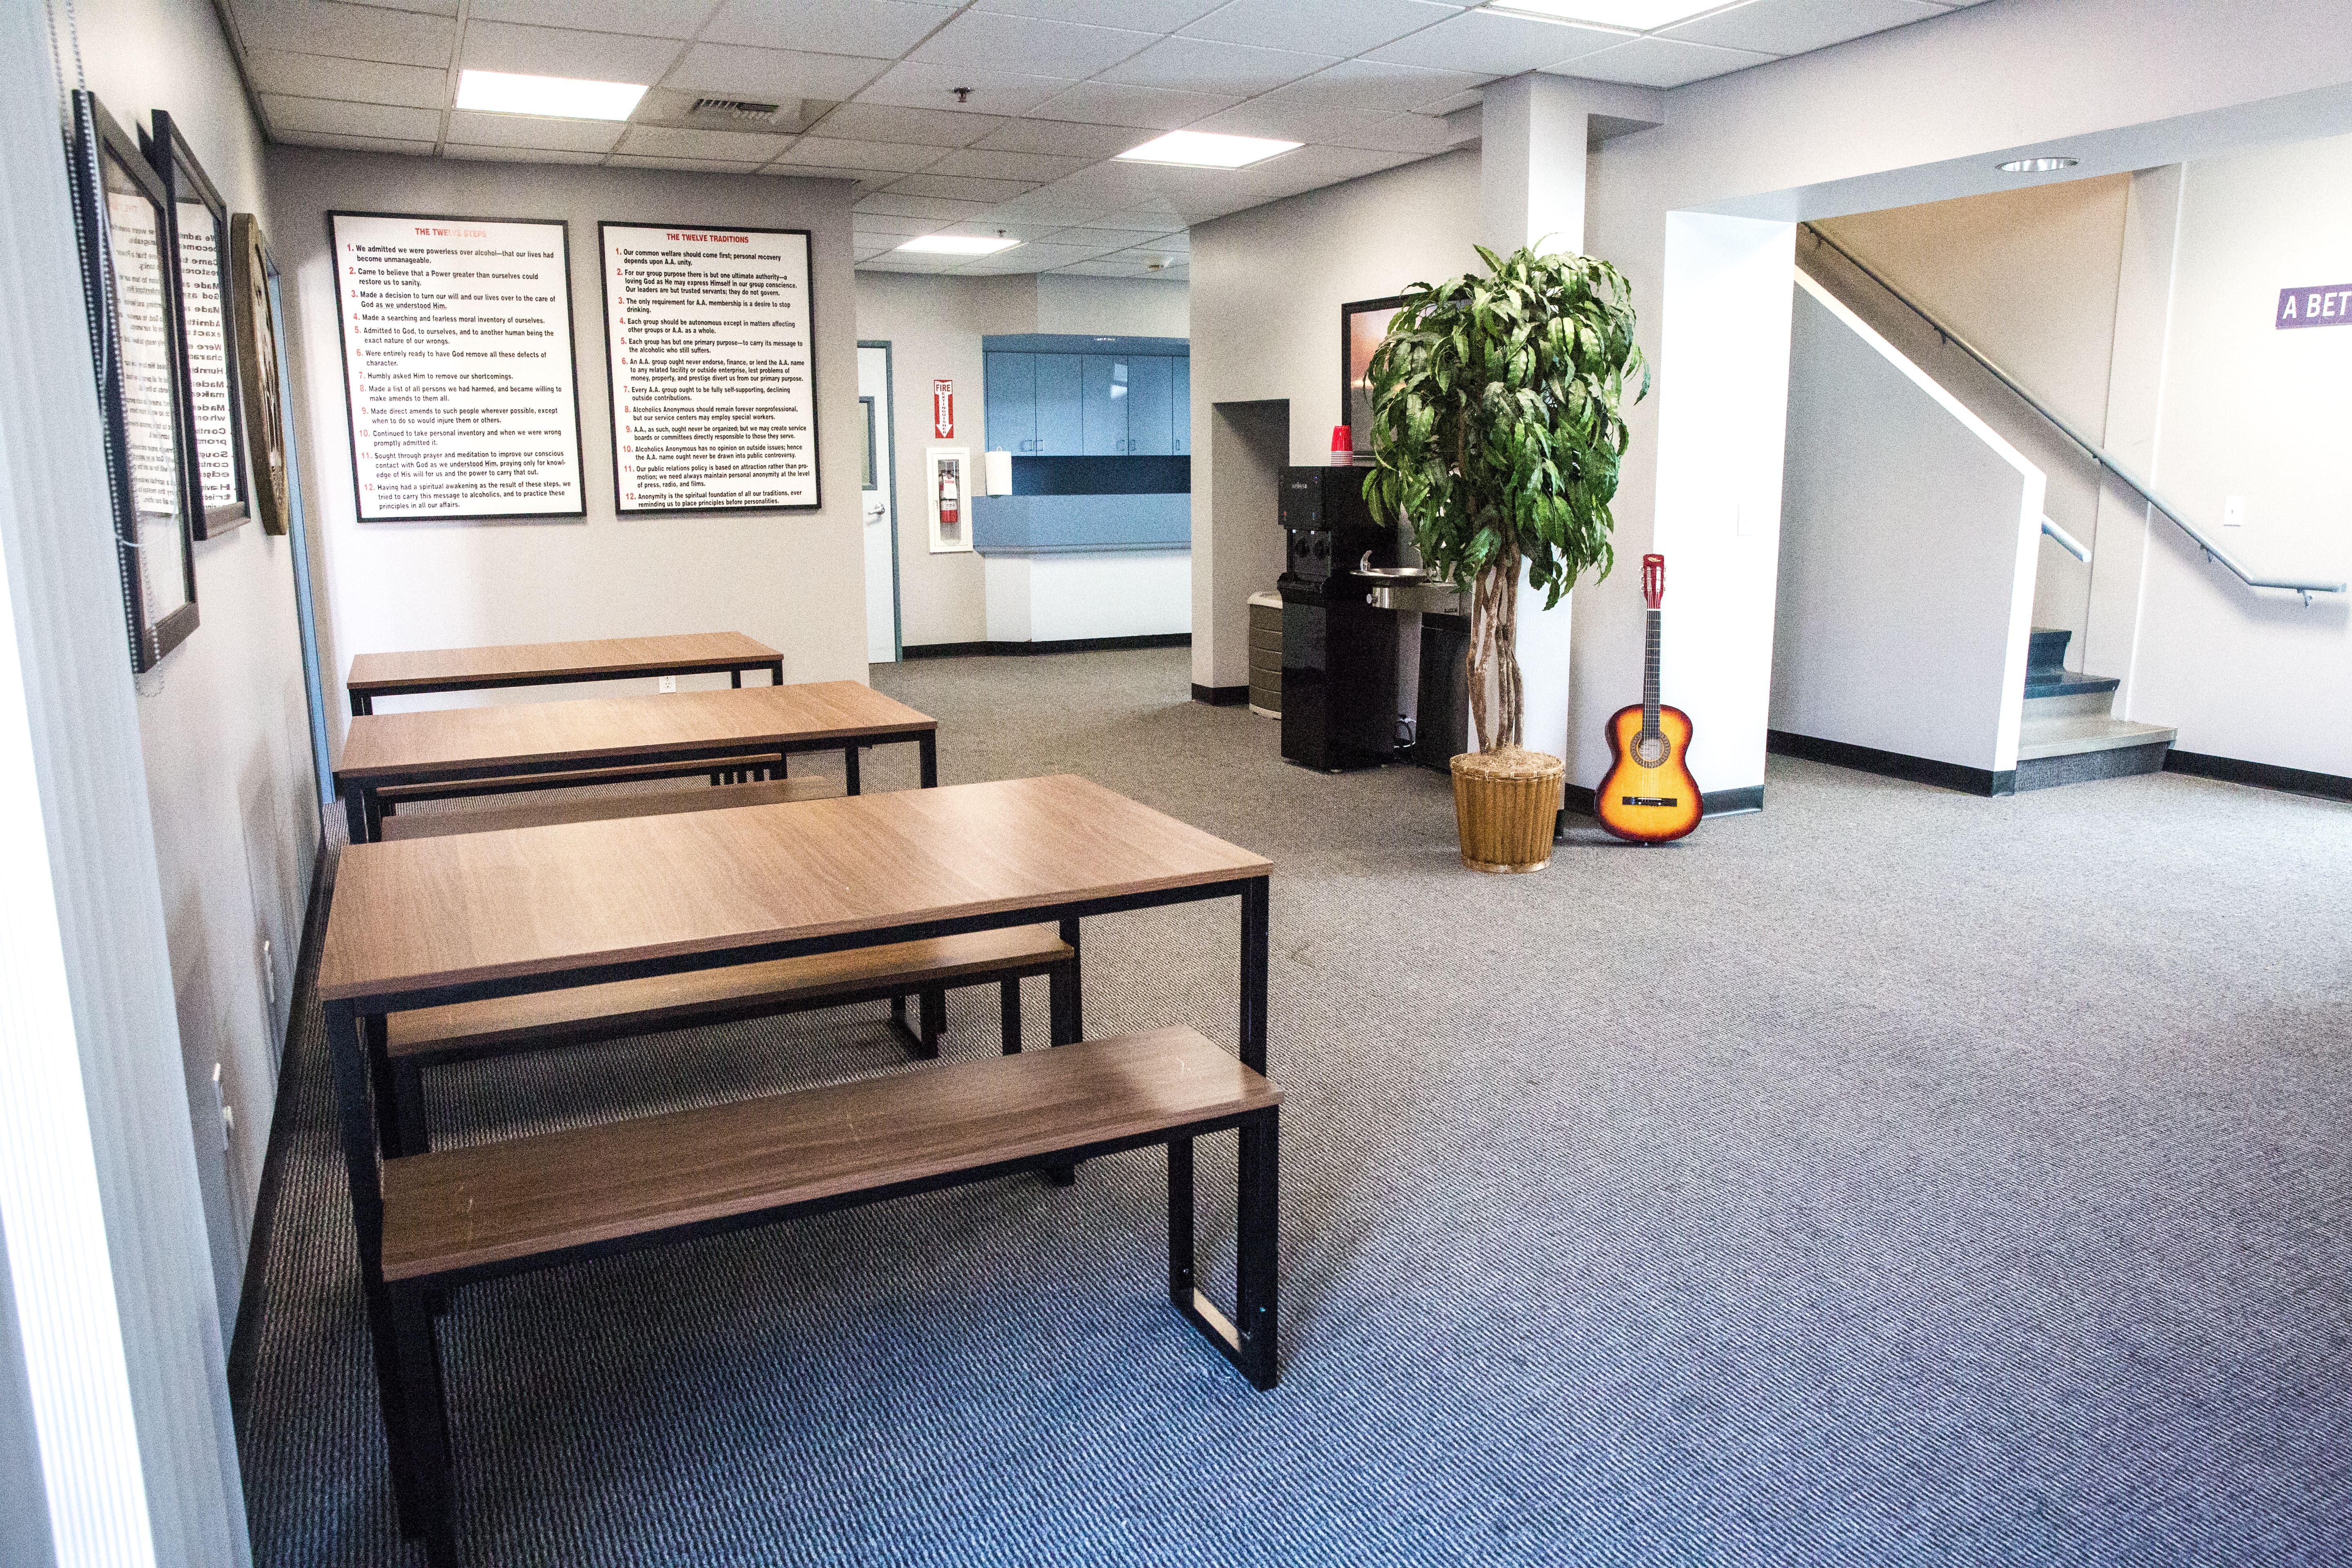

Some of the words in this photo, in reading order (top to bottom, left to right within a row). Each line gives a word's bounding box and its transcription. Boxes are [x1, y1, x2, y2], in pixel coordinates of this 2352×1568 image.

[415, 227, 430, 236] THE
[432, 228, 461, 237] TWEE
[463, 229, 487, 238] STEPS
[709, 235, 749, 243] TRADITIONS
[347, 243, 354, 252] 1.
[719, 252, 732, 260] first;
[351, 290, 358, 298] 3.
[2282, 295, 2297, 319] A
[2306, 291, 2352, 318] BET
[626, 306, 651, 314] drinking.
[477, 316, 506, 324] inventory
[471, 373, 513, 381] shortcomings.
